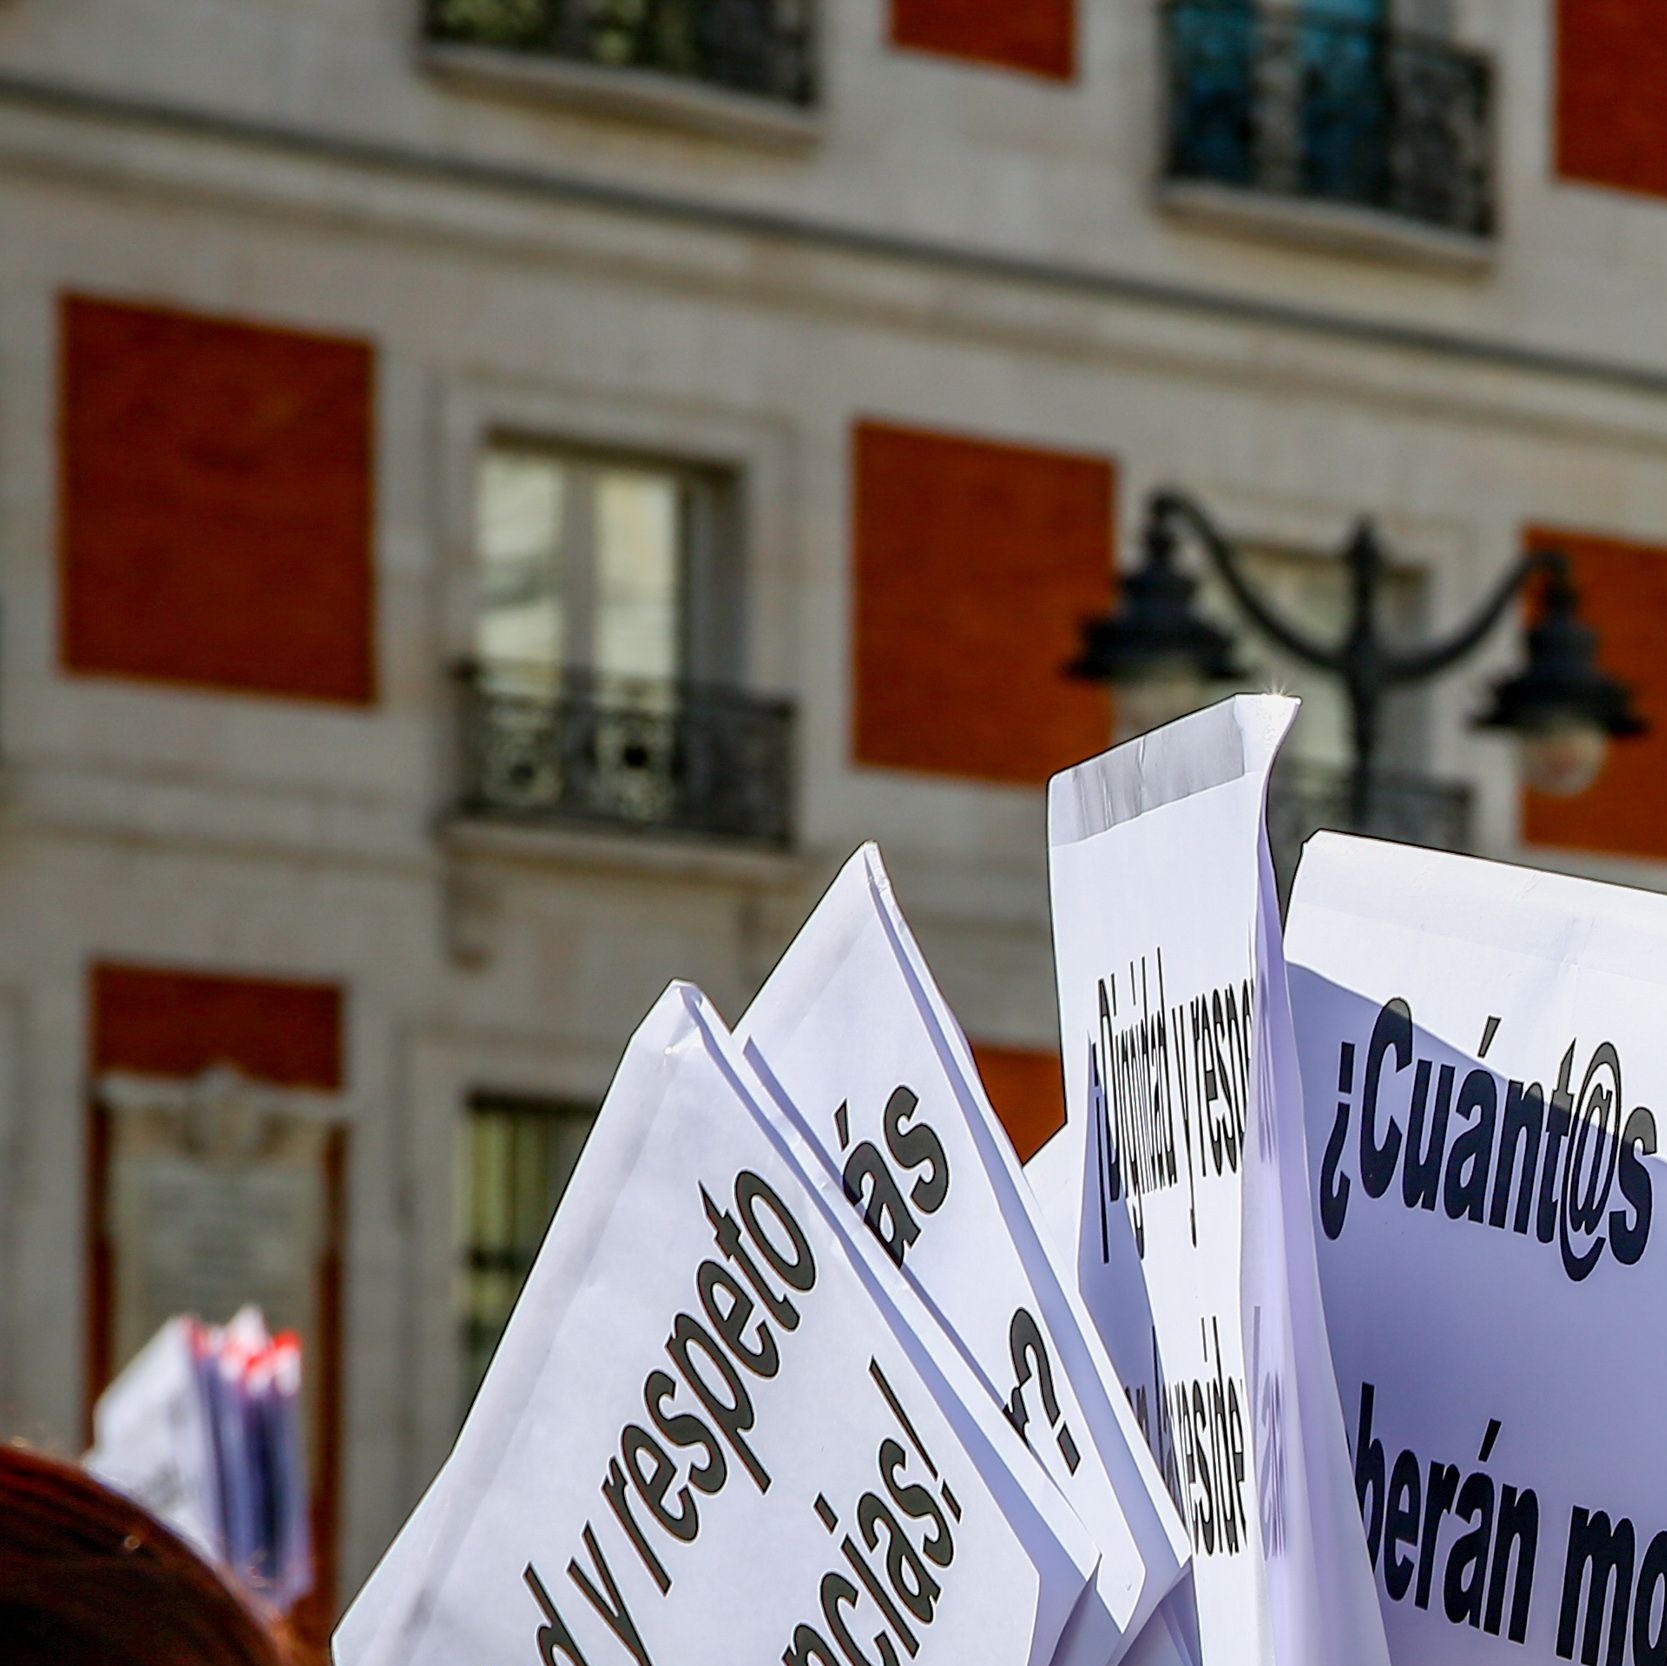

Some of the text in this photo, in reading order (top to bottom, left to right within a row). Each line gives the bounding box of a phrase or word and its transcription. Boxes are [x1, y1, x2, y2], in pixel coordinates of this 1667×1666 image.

[1172, 1004, 1197, 1248] y
[1320, 996, 1657, 1284] ¿Cuánt@s
[601, 1167, 818, 1597] respeto
[1348, 1381, 1541, 1646] berán
